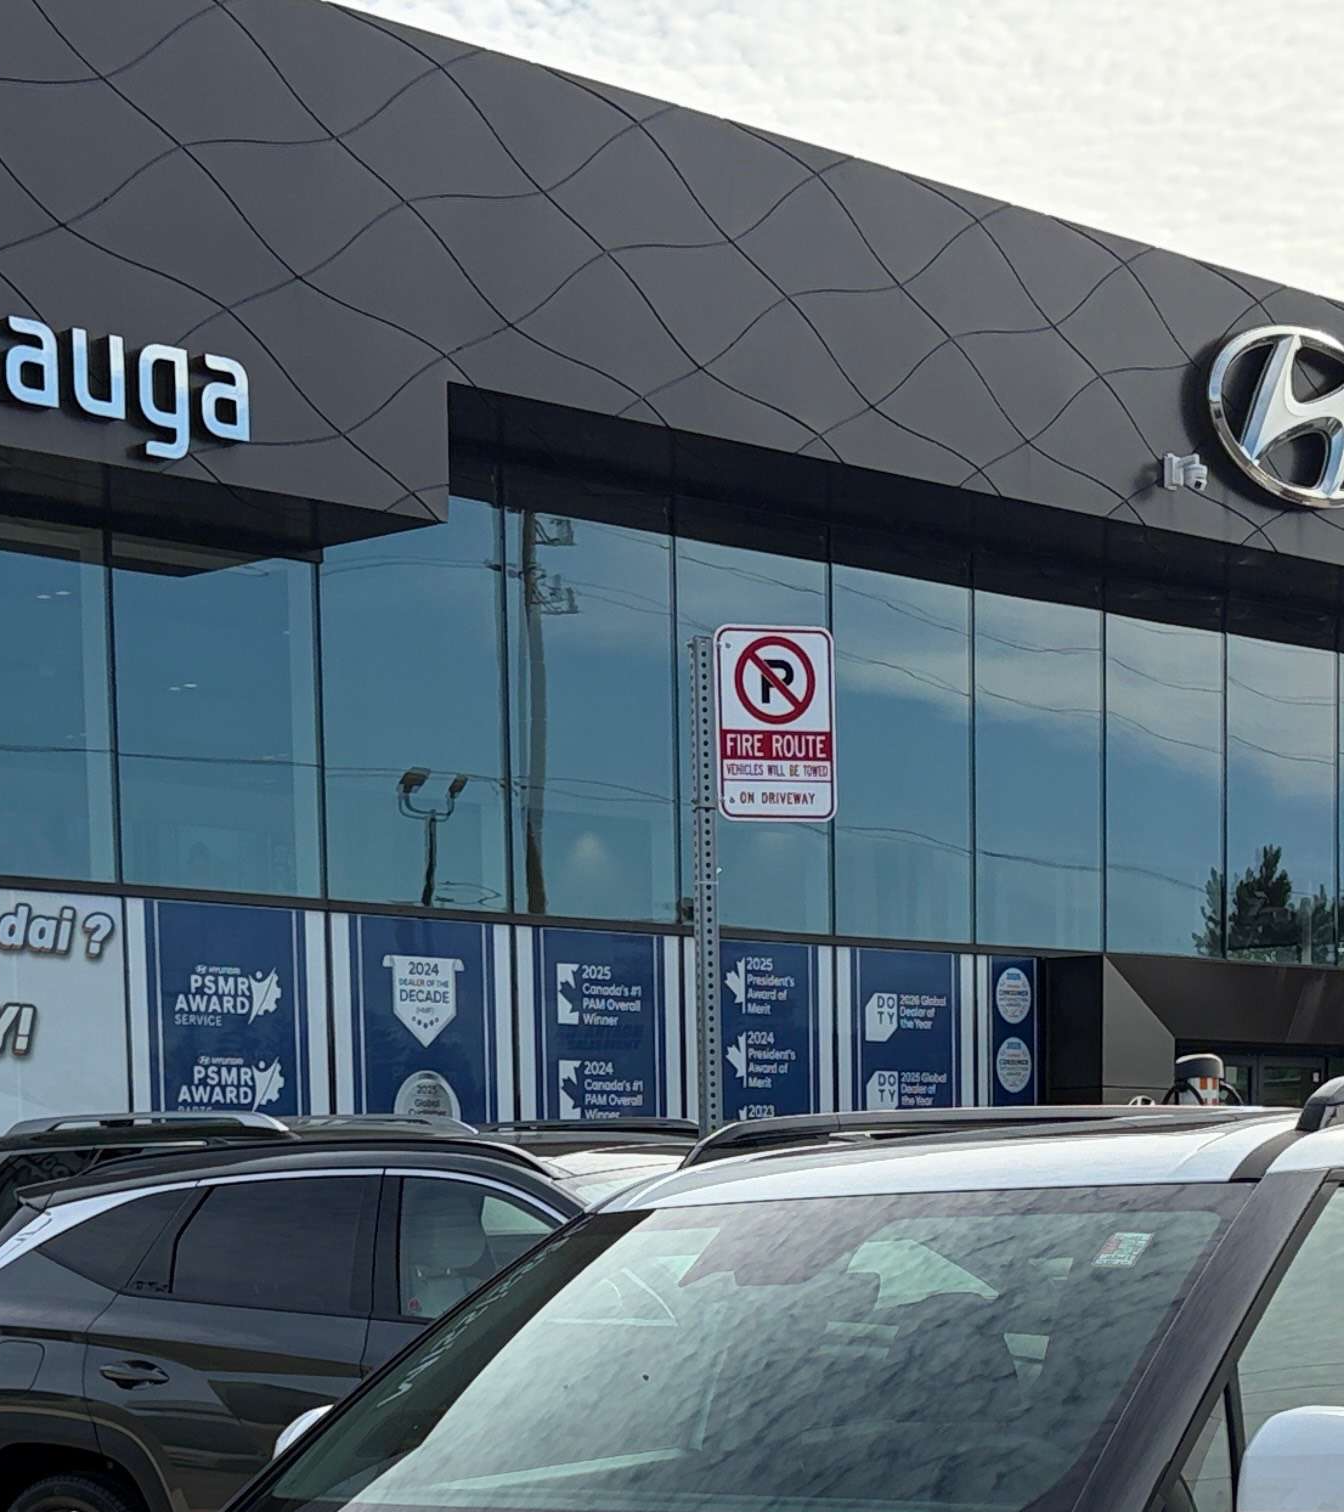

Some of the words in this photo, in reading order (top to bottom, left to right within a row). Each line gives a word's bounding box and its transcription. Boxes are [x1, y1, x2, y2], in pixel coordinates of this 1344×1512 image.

[726, 734, 764, 757] FIRE
[772, 735, 826, 758] ROUTE
[726, 763, 763, 777] VEHICLES
[767, 764, 786, 777] WILL
[789, 765, 800, 777] BE
[803, 765, 828, 778] TOWED
[740, 792, 755, 804] ON
[762, 792, 816, 805] DRIVEWAY
[408, 962, 439, 976] 2024
[746, 957, 773, 970] 2025
[582, 965, 611, 980] 2025
[191, 975, 250, 996] PSMR
[747, 975, 795, 987] President's
[400, 989, 450, 1004] DECADE
[582, 984, 628, 997] Canada's
[630, 986, 642, 997] #1
[747, 989, 777, 1000] Award
[778, 989, 787, 1000] of
[175, 994, 250, 1014] AWARD
[582, 998, 605, 1010] PAM
[607, 999, 641, 1012] Overall
[747, 1003, 771, 1015] Merit
[175, 1014, 222, 1026] SERVICE
[582, 1013, 618, 1026] Winner
[747, 1031, 774, 1044] 2024
[748, 1049, 795, 1061] President's
[584, 1061, 614, 1075] 2024
[748, 1062, 777, 1074] Award
[779, 1063, 788, 1074] of
[194, 1066, 253, 1086] PSMR
[748, 1077, 772, 1088] Merit
[584, 1079, 630, 1092] Canada's
[632, 1081, 643, 1092] #1
[178, 1085, 252, 1104] AWARD
[585, 1094, 607, 1106] PAM
[609, 1095, 643, 1106] Overall
